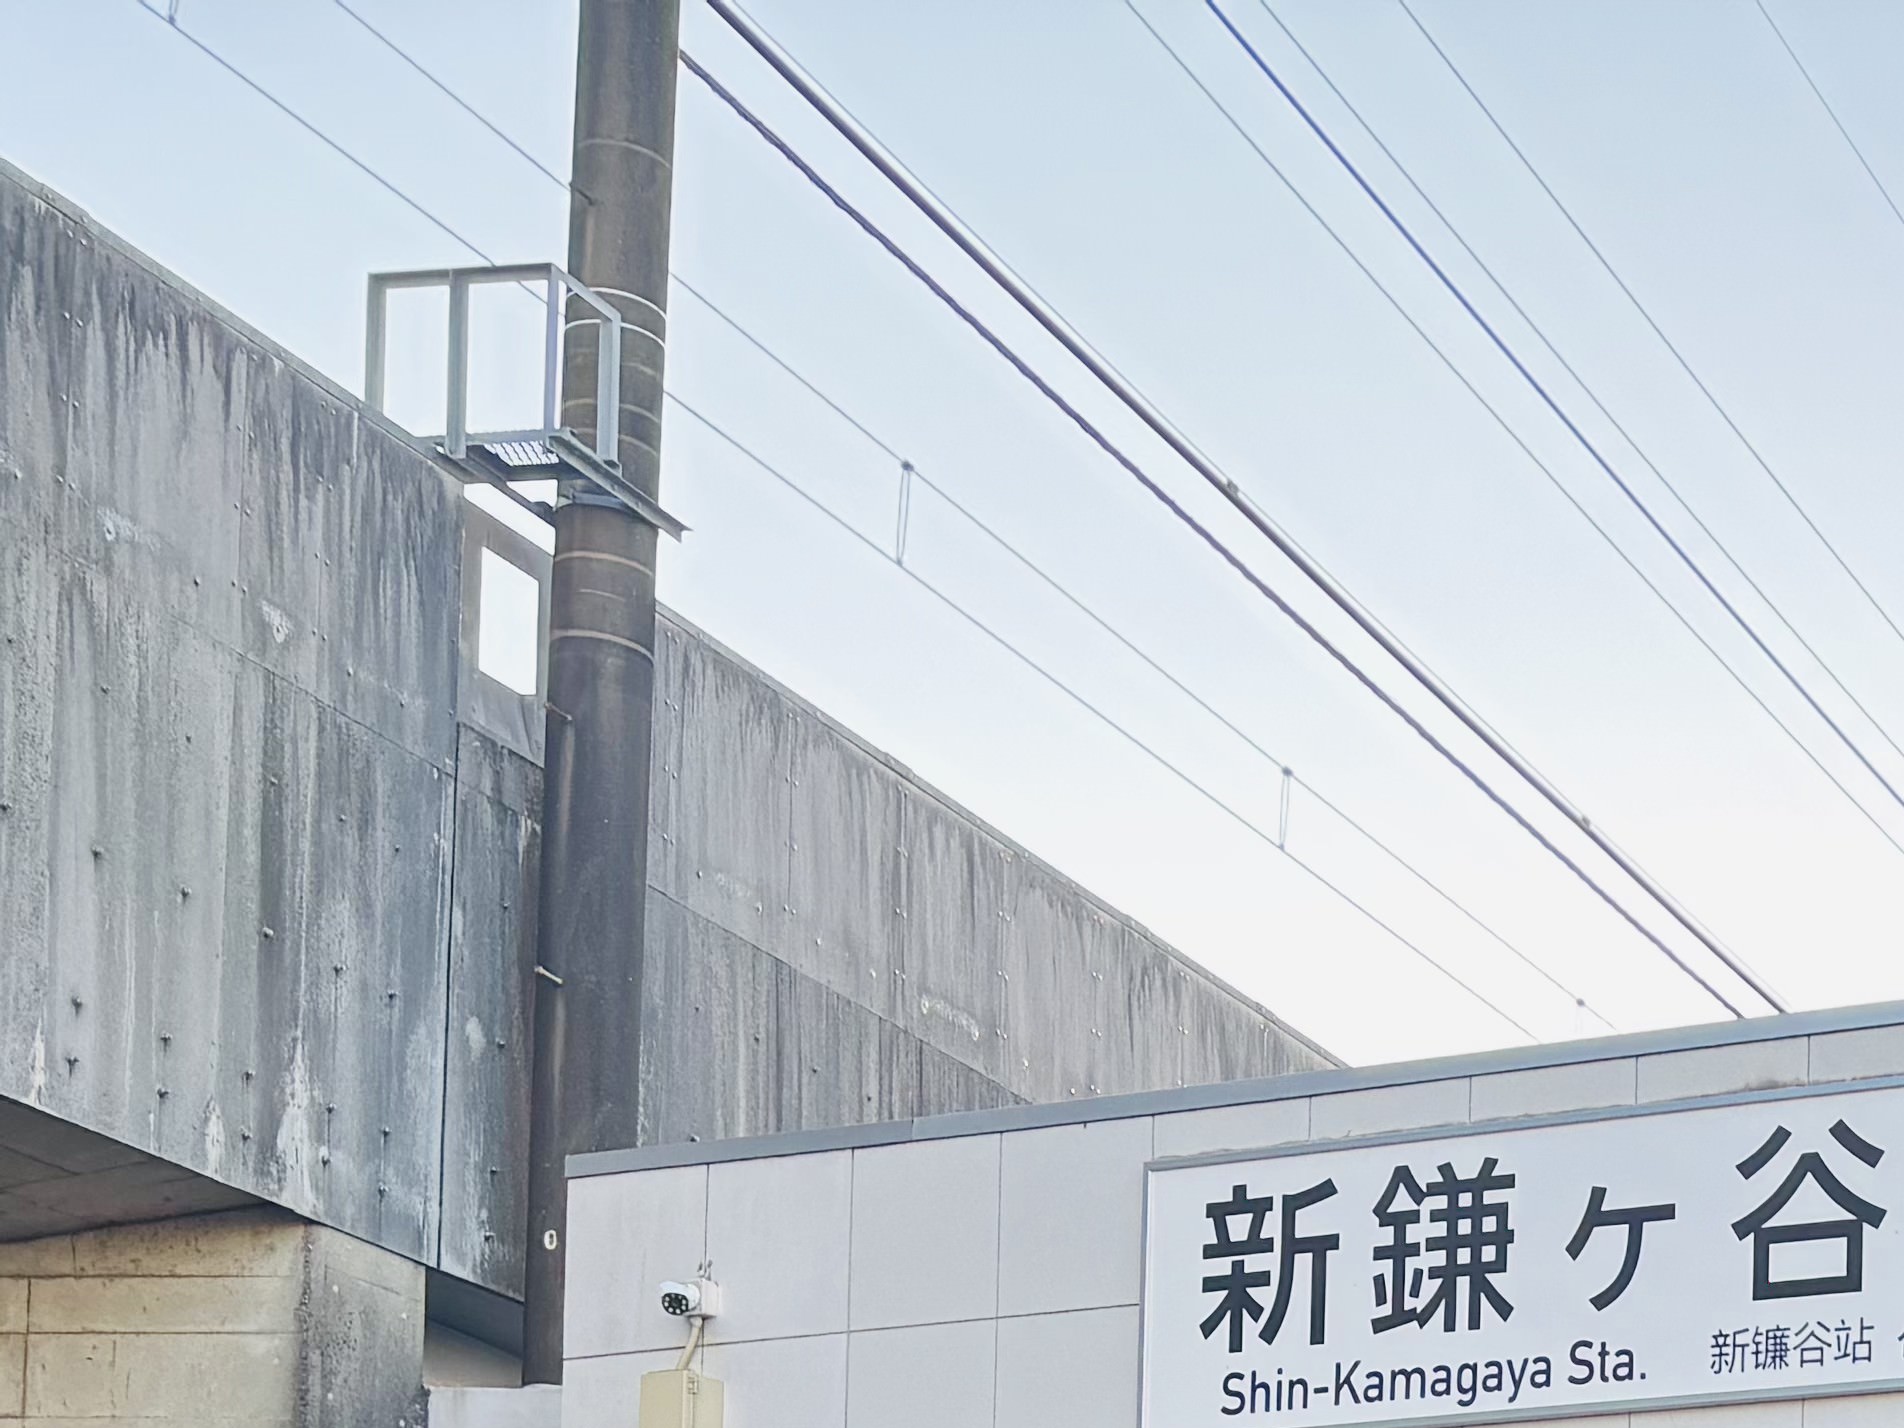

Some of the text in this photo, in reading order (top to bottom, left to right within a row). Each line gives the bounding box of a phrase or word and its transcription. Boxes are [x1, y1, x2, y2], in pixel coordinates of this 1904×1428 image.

[1220, 1342, 1647, 1417] Shin-Kamagaya Sta.
[1709, 1318, 1875, 1376] 新镰谷站
